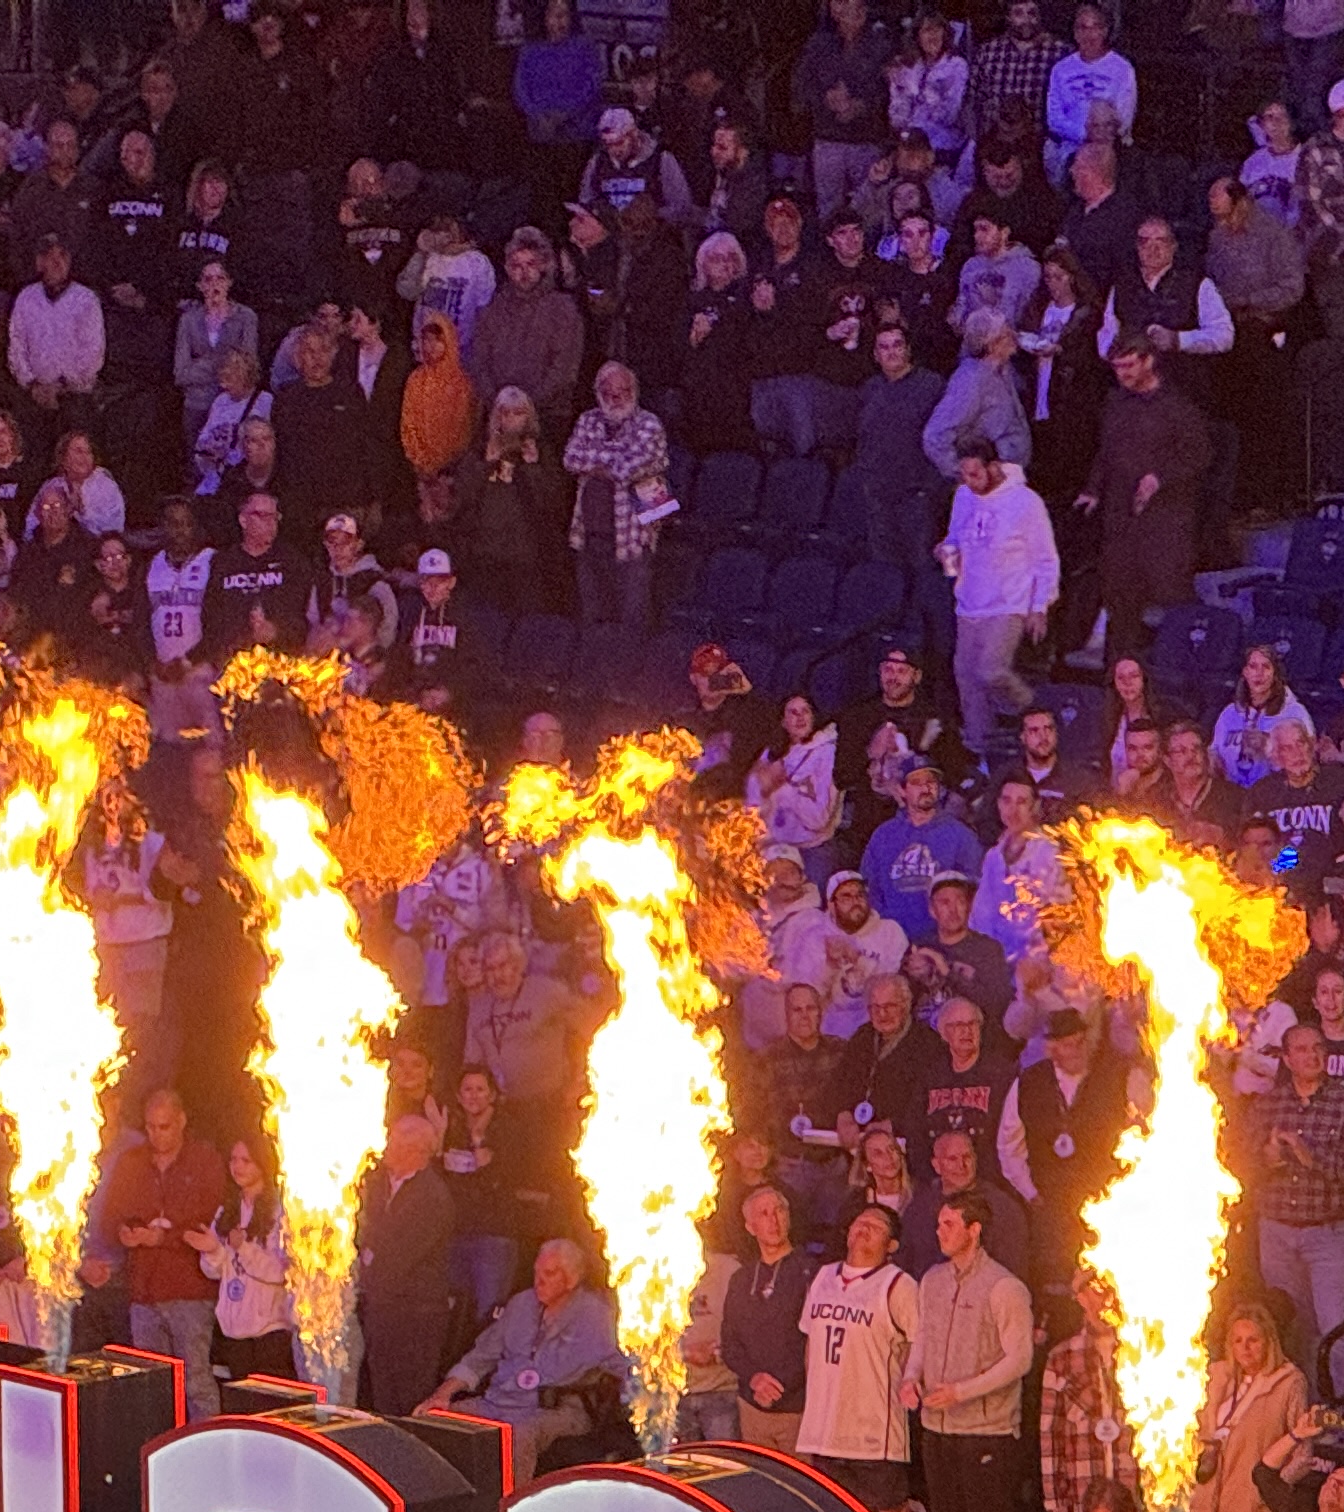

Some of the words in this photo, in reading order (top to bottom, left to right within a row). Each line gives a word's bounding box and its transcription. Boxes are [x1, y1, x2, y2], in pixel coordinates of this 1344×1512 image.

[223, 571, 283, 590] UCONN
[1266, 805, 1332, 834] CONN
[809, 1303, 874, 1328] UCONN
[825, 1324, 846, 1366] 12
